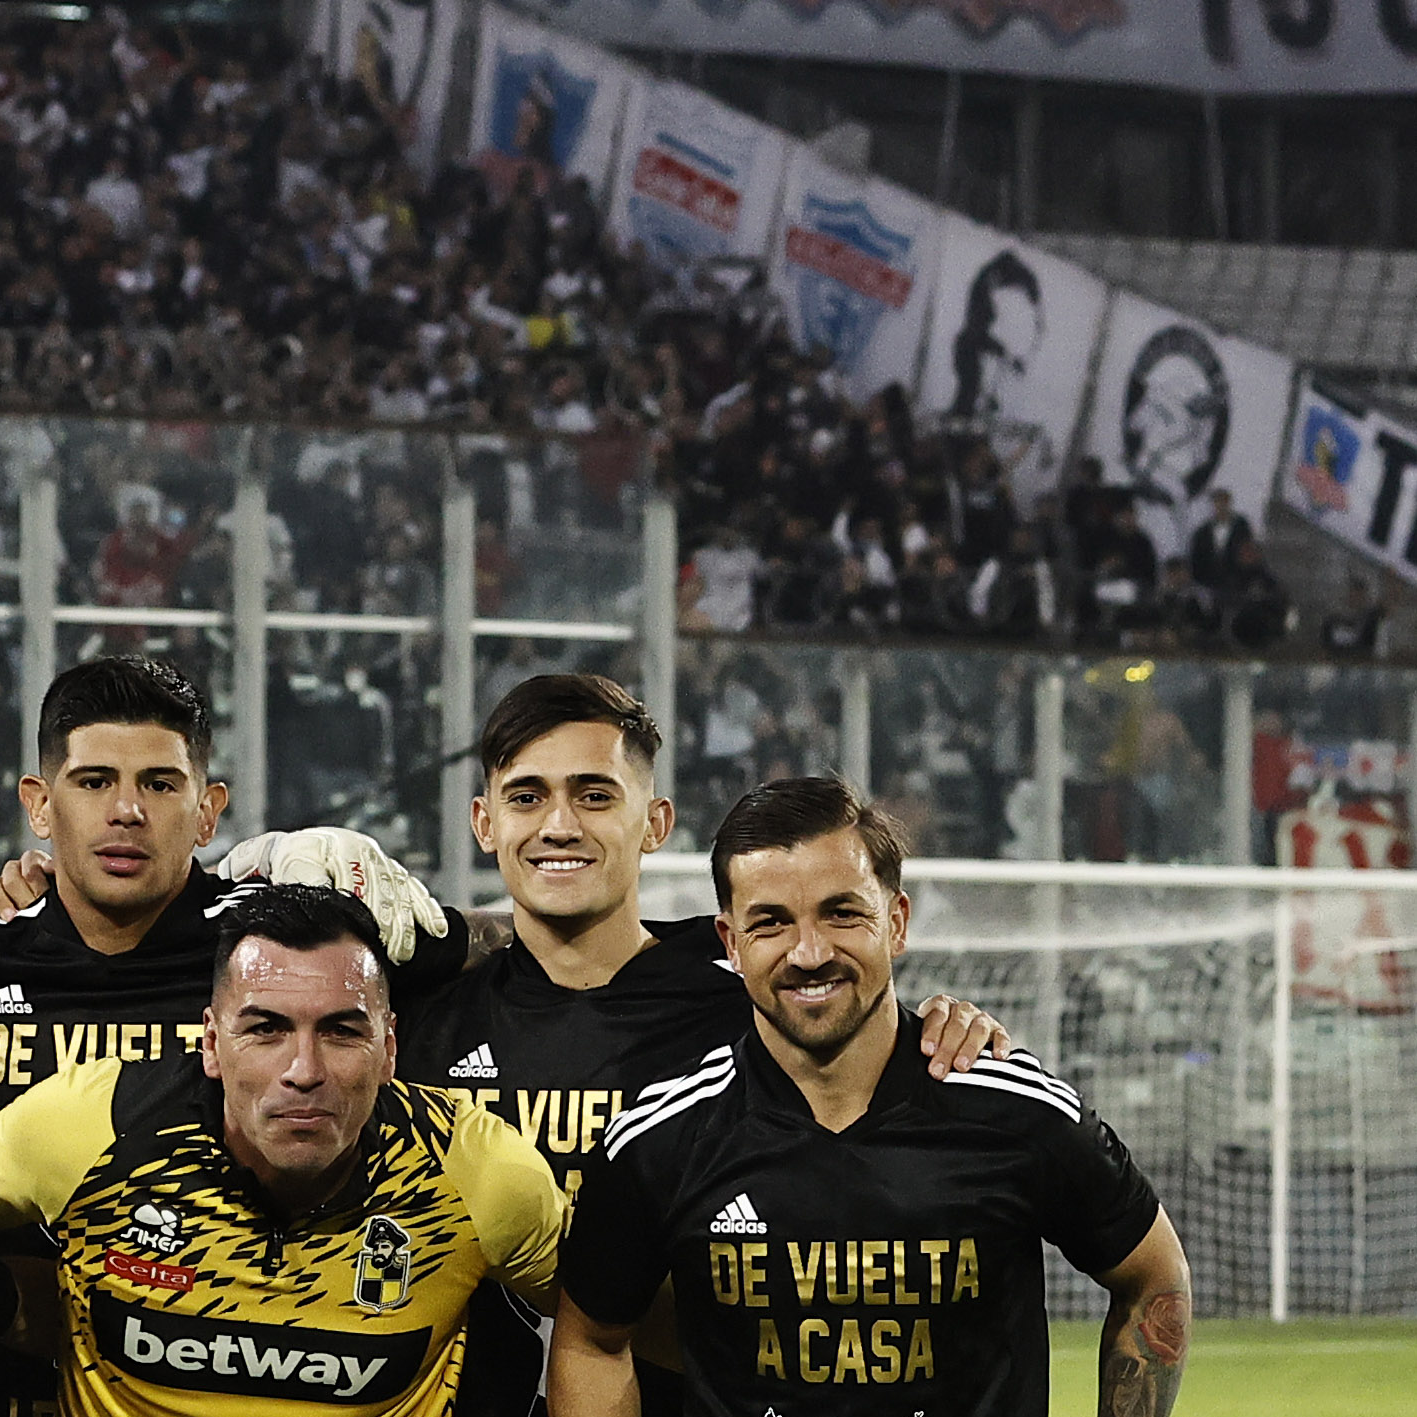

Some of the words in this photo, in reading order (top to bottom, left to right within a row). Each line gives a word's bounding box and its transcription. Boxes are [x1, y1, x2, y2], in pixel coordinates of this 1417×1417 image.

[448, 1065, 499, 1078] adidas
[709, 1219, 768, 1235] adidas
[108, 1255, 190, 1288] Celta
[708, 1241, 771, 1308] DE
[786, 1237, 981, 1307] VUELTA
[124, 1316, 389, 1397] betway
[755, 1317, 788, 1381] A
[798, 1317, 936, 1385] CASA
